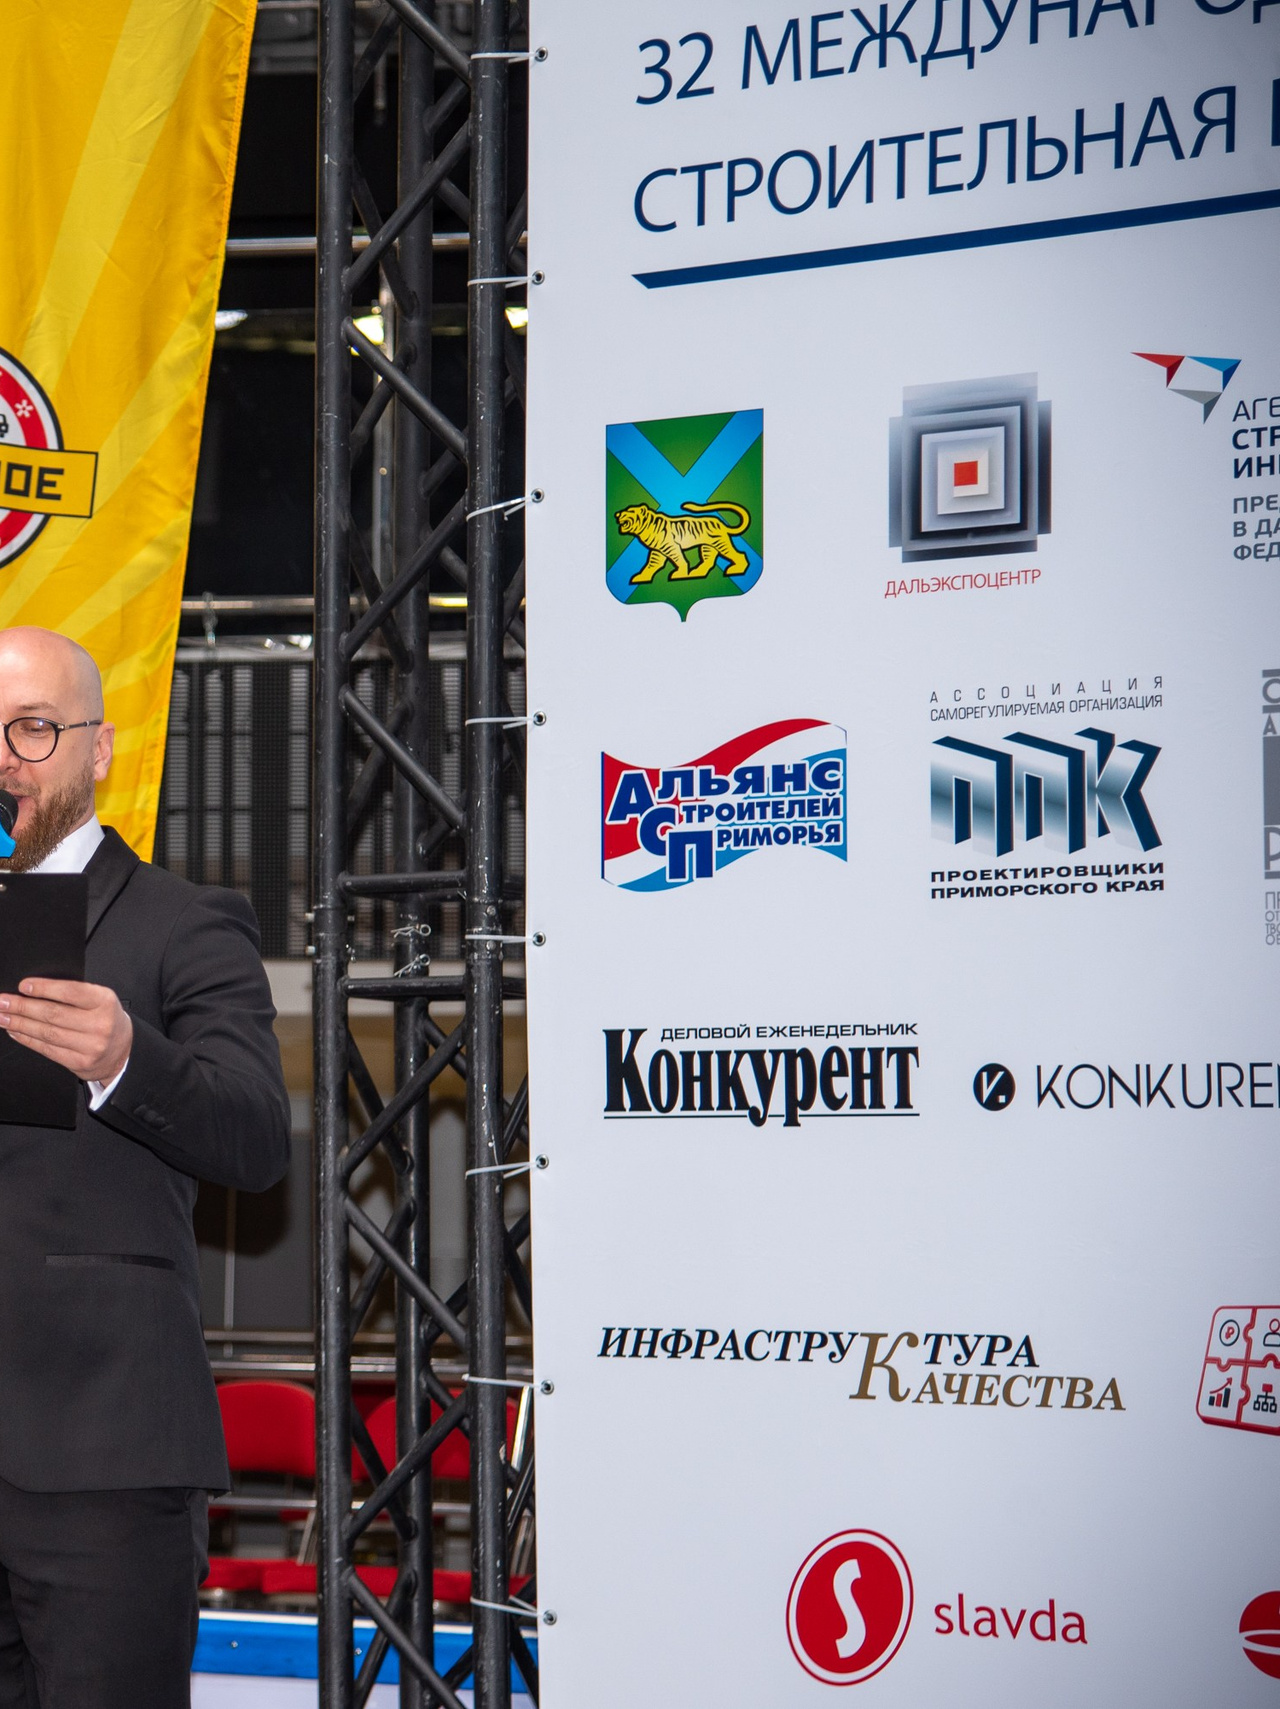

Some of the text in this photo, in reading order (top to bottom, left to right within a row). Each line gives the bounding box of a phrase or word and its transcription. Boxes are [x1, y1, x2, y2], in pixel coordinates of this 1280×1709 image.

[635, 0, 1280, 104] 32 МЕЖДУНА
[633, 85, 1236, 233] СТРОИТЕЛЬНАЯ
[1233, 454, 1280, 479] ИН
[1233, 494, 1280, 514] ПРЕ
[884, 568, 1042, 599] ДАЛЬЭКСПОЦЕНТР
[929, 675, 1163, 704] АССОЦИАЦИЯ
[930, 694, 1163, 722] САМОРЕГУЛИРУЕМАЯ ОРГАНИЗАЦИЯ
[931, 862, 1164, 883] ПРОЕКТИРОВЩИКИ
[931, 879, 1164, 900] ПРИМОРСКОГО КРАЯ
[661, 1023, 918, 1042] ДЕЛОВОЙ ЕЖЕНЕДЕЛЬНИК
[602, 1028, 920, 1127] Конкурент
[1036, 1061, 1280, 1110] KONKURE
[934, 1592, 1089, 1645] slavda
